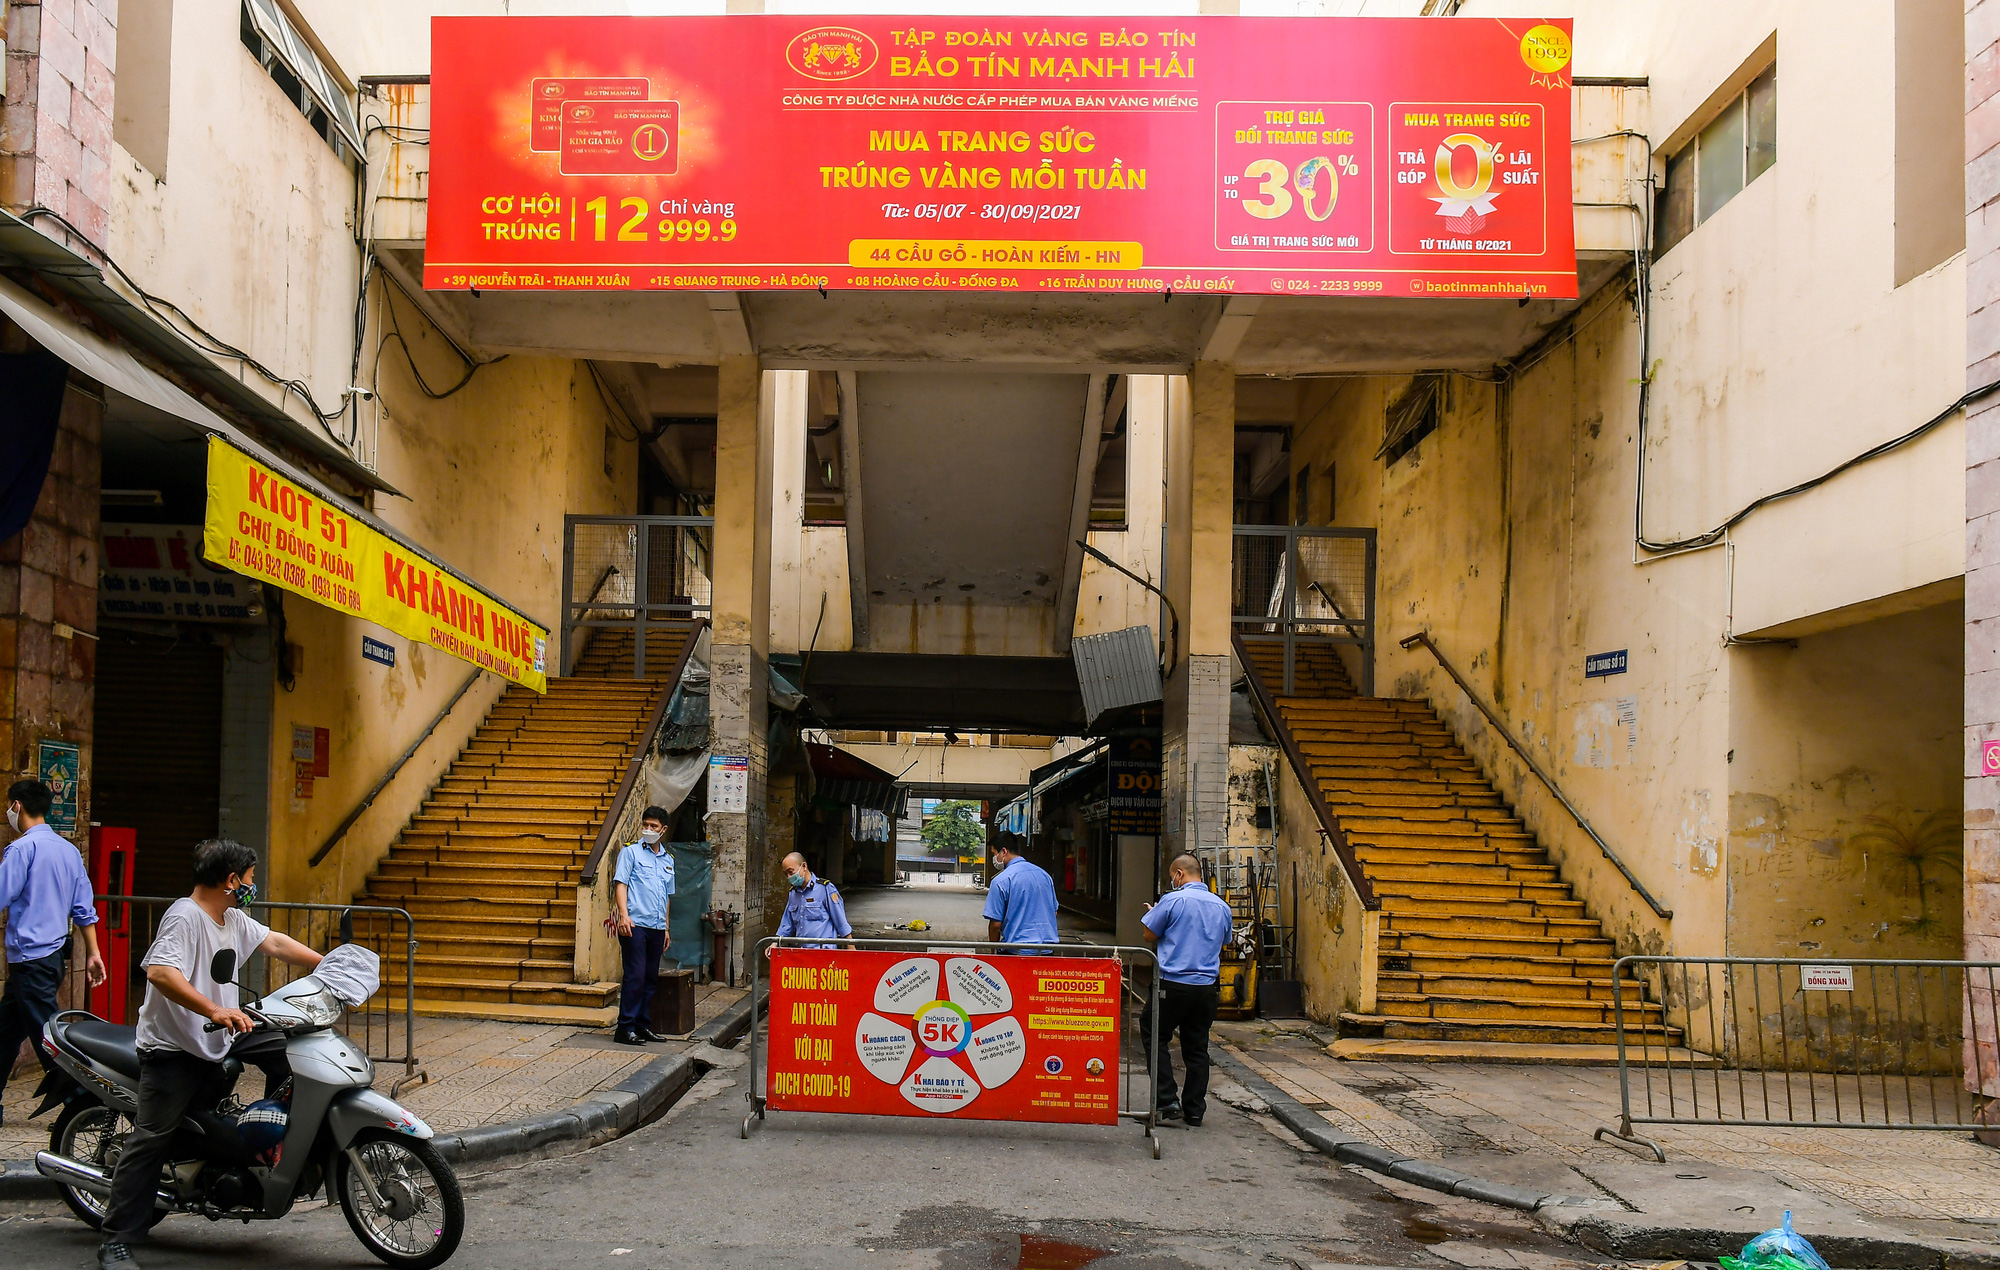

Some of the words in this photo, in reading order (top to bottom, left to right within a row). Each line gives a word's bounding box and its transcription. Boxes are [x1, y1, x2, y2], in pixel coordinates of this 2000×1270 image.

[890, 28, 936, 48] TẬP
[945, 28, 1012, 46] ĐOÀN
[1022, 28, 1088, 46] VÀNG
[1099, 28, 1148, 46] BẢO
[1158, 28, 1196, 46] TÍN
[1527, 36, 1564, 46] SINCE
[1527, 48, 1567, 59] 1992
[890, 50, 960, 77] BẢO
[966, 52, 1020, 77] TÍN
[1030, 57, 1128, 82] MẠNH
[1139, 51, 1194, 78] HẢI
[782, 94, 823, 106] CÔNG
[826, 96, 843, 106] TY
[846, 94, 886, 107] ĐƯỢC
[889, 94, 920, 106] NHÀ
[923, 94, 964, 106] NƯỚC
[966, 93, 996, 106] CẤP
[1000, 95, 1037, 106] PHÉP
[1041, 96, 1072, 106] MUA
[1075, 95, 1105, 106] BÁN
[1108, 95, 1149, 107] VÀNG
[1153, 94, 1198, 107] MIẾNG
[1264, 109, 1294, 127] TRỢ
[1299, 108, 1325, 124] GIÁ
[1404, 114, 1440, 127] MUA
[1444, 114, 1494, 127] TRANG
[1500, 111, 1531, 127] SỨC
[869, 130, 930, 151] MUA
[938, 130, 1031, 153] TRANG
[1039, 125, 1095, 153] SỨC
[1235, 125, 1262, 144] ĐỔI
[1266, 131, 1317, 144] TRANG
[1322, 128, 1354, 145] SỨC
[1398, 149, 1426, 164] TRẢ
[1510, 150, 1532, 165] LÃI
[819, 160, 911, 188] TRÚNG
[919, 161, 1001, 189] VÀNG
[1010, 158, 1065, 190] MỖI
[1074, 158, 1146, 190] TUẦN
[1224, 175, 1239, 185] UP
[1398, 169, 1427, 184] GÓP
[1503, 168, 1539, 184] SUẤT
[1224, 190, 1238, 198] TO
[481, 196, 515, 214] CƠ
[520, 192, 560, 218] HỘI
[586, 196, 649, 242] 12
[659, 198, 688, 214] Chỉ
[692, 199, 735, 218] vàng
[914, 204, 967, 223] 05/07
[980, 204, 1081, 223] 30/09/2021
[481, 218, 560, 240] TRÚNG
[658, 219, 737, 242] 999.9
[1231, 234, 1249, 246] GIÁ
[1252, 236, 1269, 248] TRỊ
[1273, 236, 1308, 247] TRANG
[1312, 234, 1333, 247] SỨC
[1337, 235, 1359, 247] MỚI
[1420, 238, 1435, 250] TỪ
[1436, 238, 1473, 250] THÁNG
[1475, 240, 1512, 250] 8/2021
[870, 249, 891, 262] 44
[896, 242, 934, 262] CẦU
[938, 243, 967, 262] GỖ
[982, 246, 1033, 263] HOÀN
[1039, 244, 1080, 263] KIẾM
[1096, 250, 1121, 263] HN
[452, 275, 466, 286] 39
[469, 272, 517, 286] NGUYỄN
[519, 272, 544, 286] TRÃI
[553, 276, 593, 286] THANH
[596, 274, 630, 286] XUÂN
[657, 276, 670, 286] 15
[674, 276, 718, 286] QUANG
[721, 276, 761, 286] TRUNG
[770, 276, 788, 286] HÀ
[790, 274, 829, 286] ĐÔNG
[855, 276, 870, 287] 08
[873, 275, 920, 287] HOÀNG
[922, 272, 949, 287] CẦU
[959, 273, 997, 287] ĐỐNG
[1000, 277, 1019, 288] ĐA
[1046, 278, 1061, 288] 16
[1064, 274, 1095, 288] TRẦN
[1099, 278, 1124, 288] DUY
[1127, 278, 1163, 289] HƯNG
[1173, 275, 1201, 290] CẦU
[1203, 275, 1235, 290] GIẤY
[1288, 280, 1310, 291] 024
[1320, 280, 1350, 291] 2233
[1353, 281, 1383, 292] 9999
[1426, 280, 1547, 293] baotinmanhhaivn
[249, 466, 312, 531] KIOT
[320, 507, 347, 549] 51
[238, 511, 272, 549] CHỢ
[276, 528, 316, 565] ĐỒNG
[320, 549, 354, 582] XUÂN
[244, 544, 263, 572] 043
[265, 553, 281, 579] 928
[284, 562, 306, 588] 0368
[312, 574, 330, 599] 0933
[333, 583, 346, 605] 166
[349, 589, 361, 612] 689
[384, 550, 484, 642] KHÁNH
[491, 611, 532, 671] HUỆ
[430, 626, 459, 652] CHUYÊN
[460, 640, 475, 661] BÁN
[476, 649, 493, 668] BUÔN
[1597, 658, 1610, 671] THANG
[1611, 653, 1618, 668] SỐ
[1619, 656, 1625, 667] 13
[781, 966, 817, 990] CHUNG
[820, 960, 849, 991] SỐNG
[902, 966, 918, 979] TRANG
[1829, 977, 1847, 985] XUÂN
[1044, 981, 1099, 992] 19009095
[791, 1002, 807, 1024] AN
[810, 998, 837, 1026] TOÀN
[1033, 1017, 1109, 1028] https://www.bluezone.gov.vn
[923, 1023, 959, 1043] 5K
[794, 1033, 811, 1060] VỚI
[814, 1038, 832, 1066] ĐẠI
[775, 1072, 800, 1100] DỊCH
[803, 1073, 851, 1098] COVID-19
[914, 1073, 934, 1086] KHAI
[935, 1078, 950, 1086] BÁO
[957, 1076, 965, 1087] TẾ
